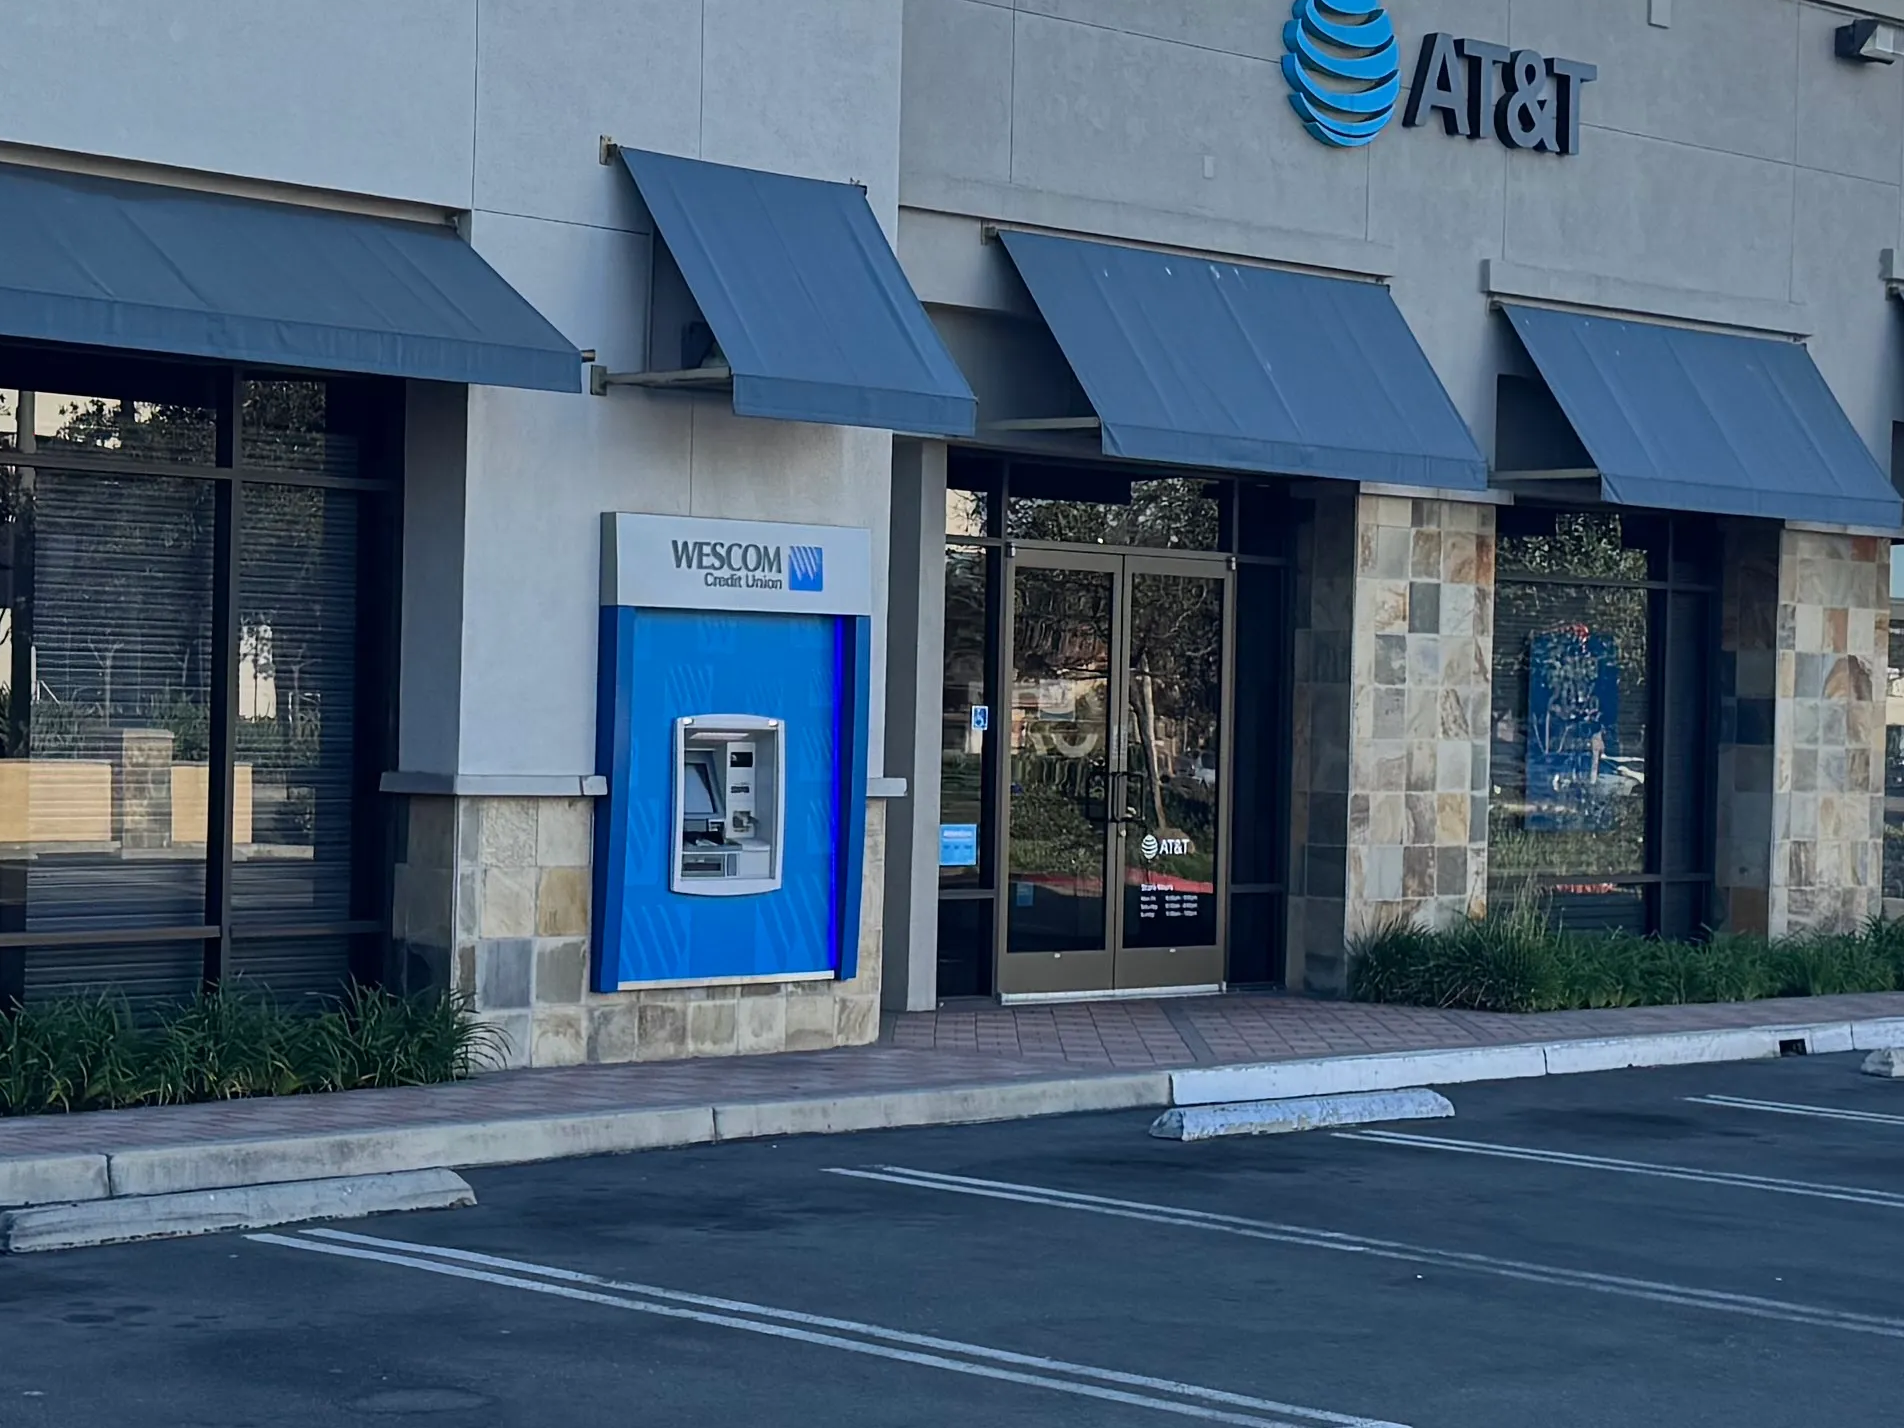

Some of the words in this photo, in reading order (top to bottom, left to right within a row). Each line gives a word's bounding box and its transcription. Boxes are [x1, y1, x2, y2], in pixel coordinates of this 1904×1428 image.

[1402, 32, 1597, 155] AT&T
[671, 539, 782, 574] WESCOM
[704, 572, 742, 588] Credit
[746, 573, 783, 590] Union
[1159, 838, 1190, 855] AT&T
